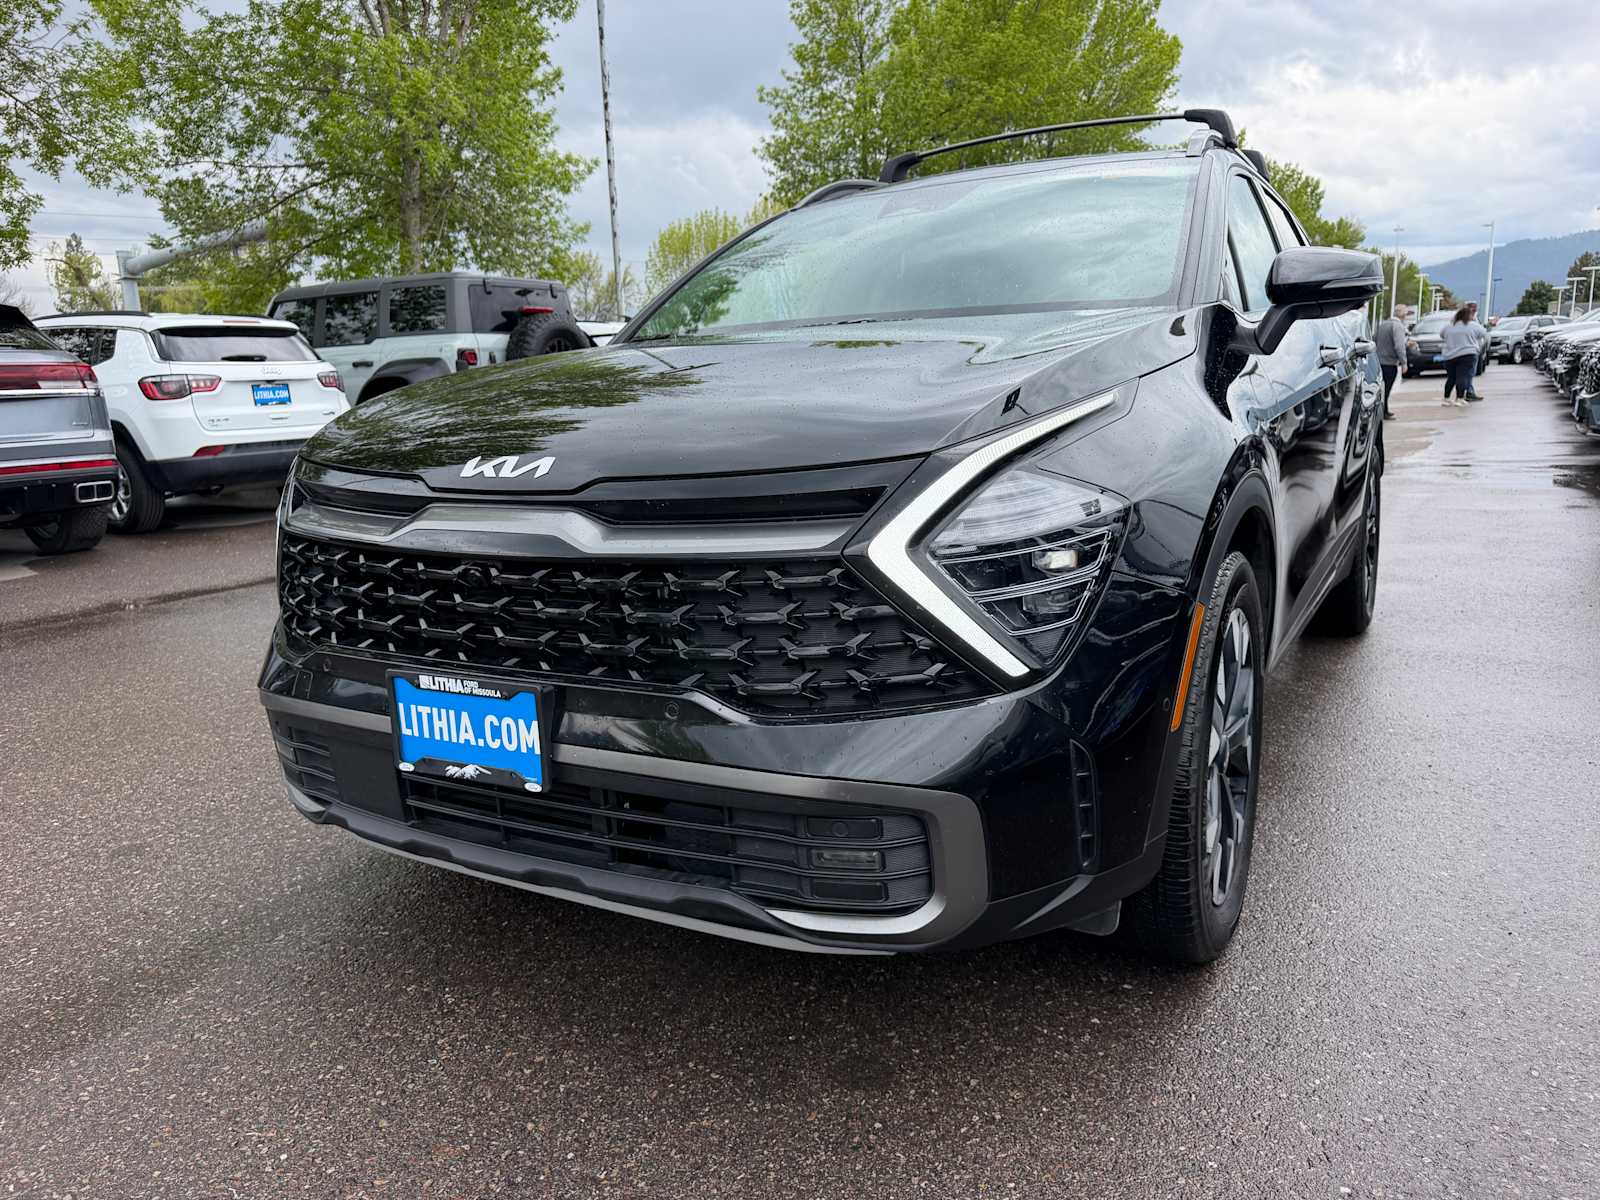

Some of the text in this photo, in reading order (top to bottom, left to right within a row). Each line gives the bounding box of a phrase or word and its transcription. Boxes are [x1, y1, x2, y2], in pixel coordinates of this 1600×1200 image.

[254, 389, 289, 399] LITHIA.COM
[430, 676, 465, 693] LITHIA
[463, 680, 478, 688] FORD
[472, 688, 501, 698] MISSOULA
[398, 702, 541, 755] LITHIA.COM
